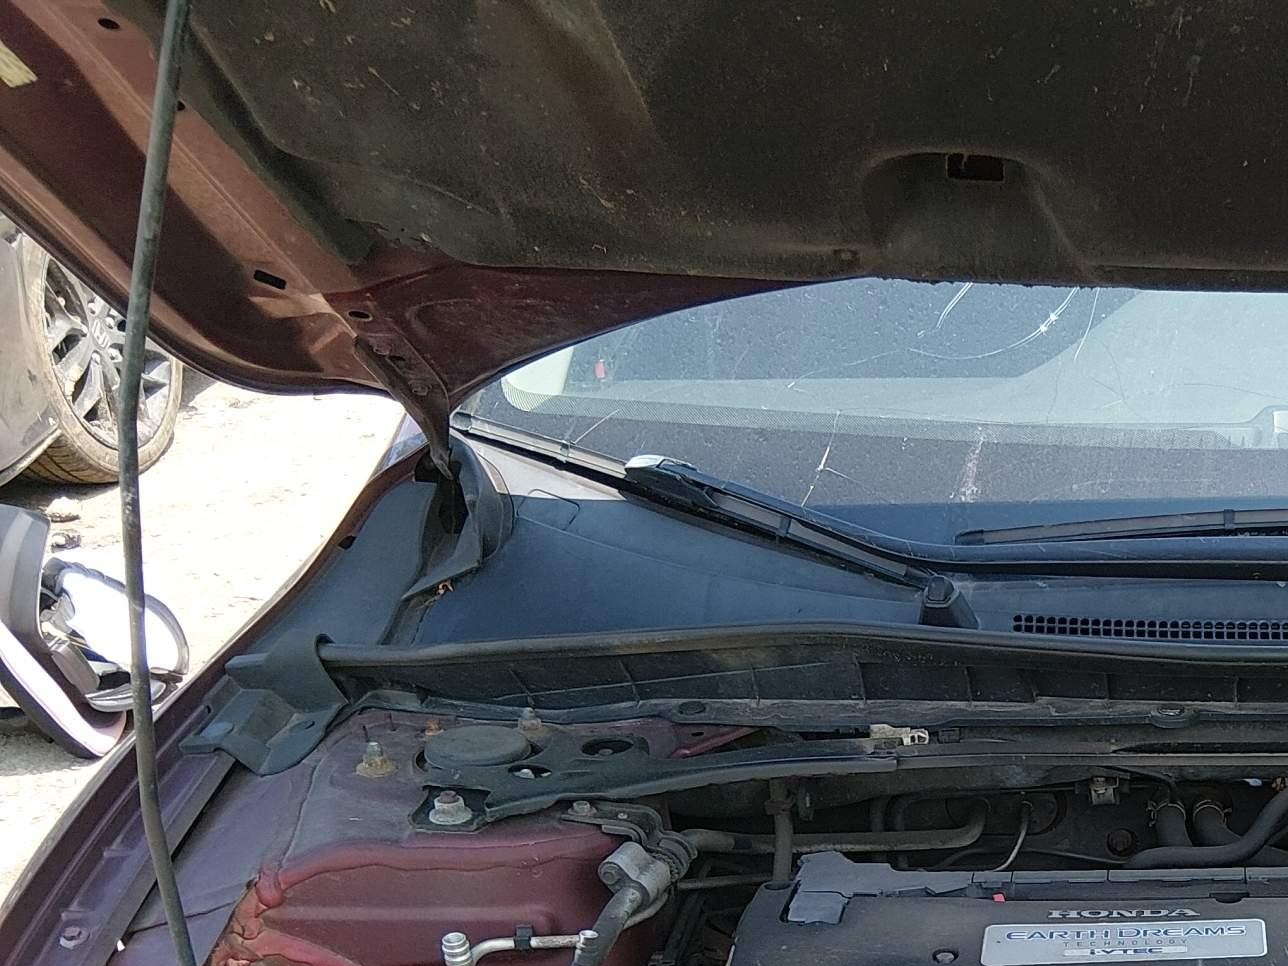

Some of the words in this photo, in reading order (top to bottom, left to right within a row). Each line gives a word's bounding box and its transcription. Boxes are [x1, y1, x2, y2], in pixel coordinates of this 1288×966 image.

[1047, 908, 1200, 919] HONDA
[1006, 927, 1110, 941] EARTH
[1118, 925, 1247, 939] DREAMS
[1063, 938, 1188, 948] TECHNOLOGY
